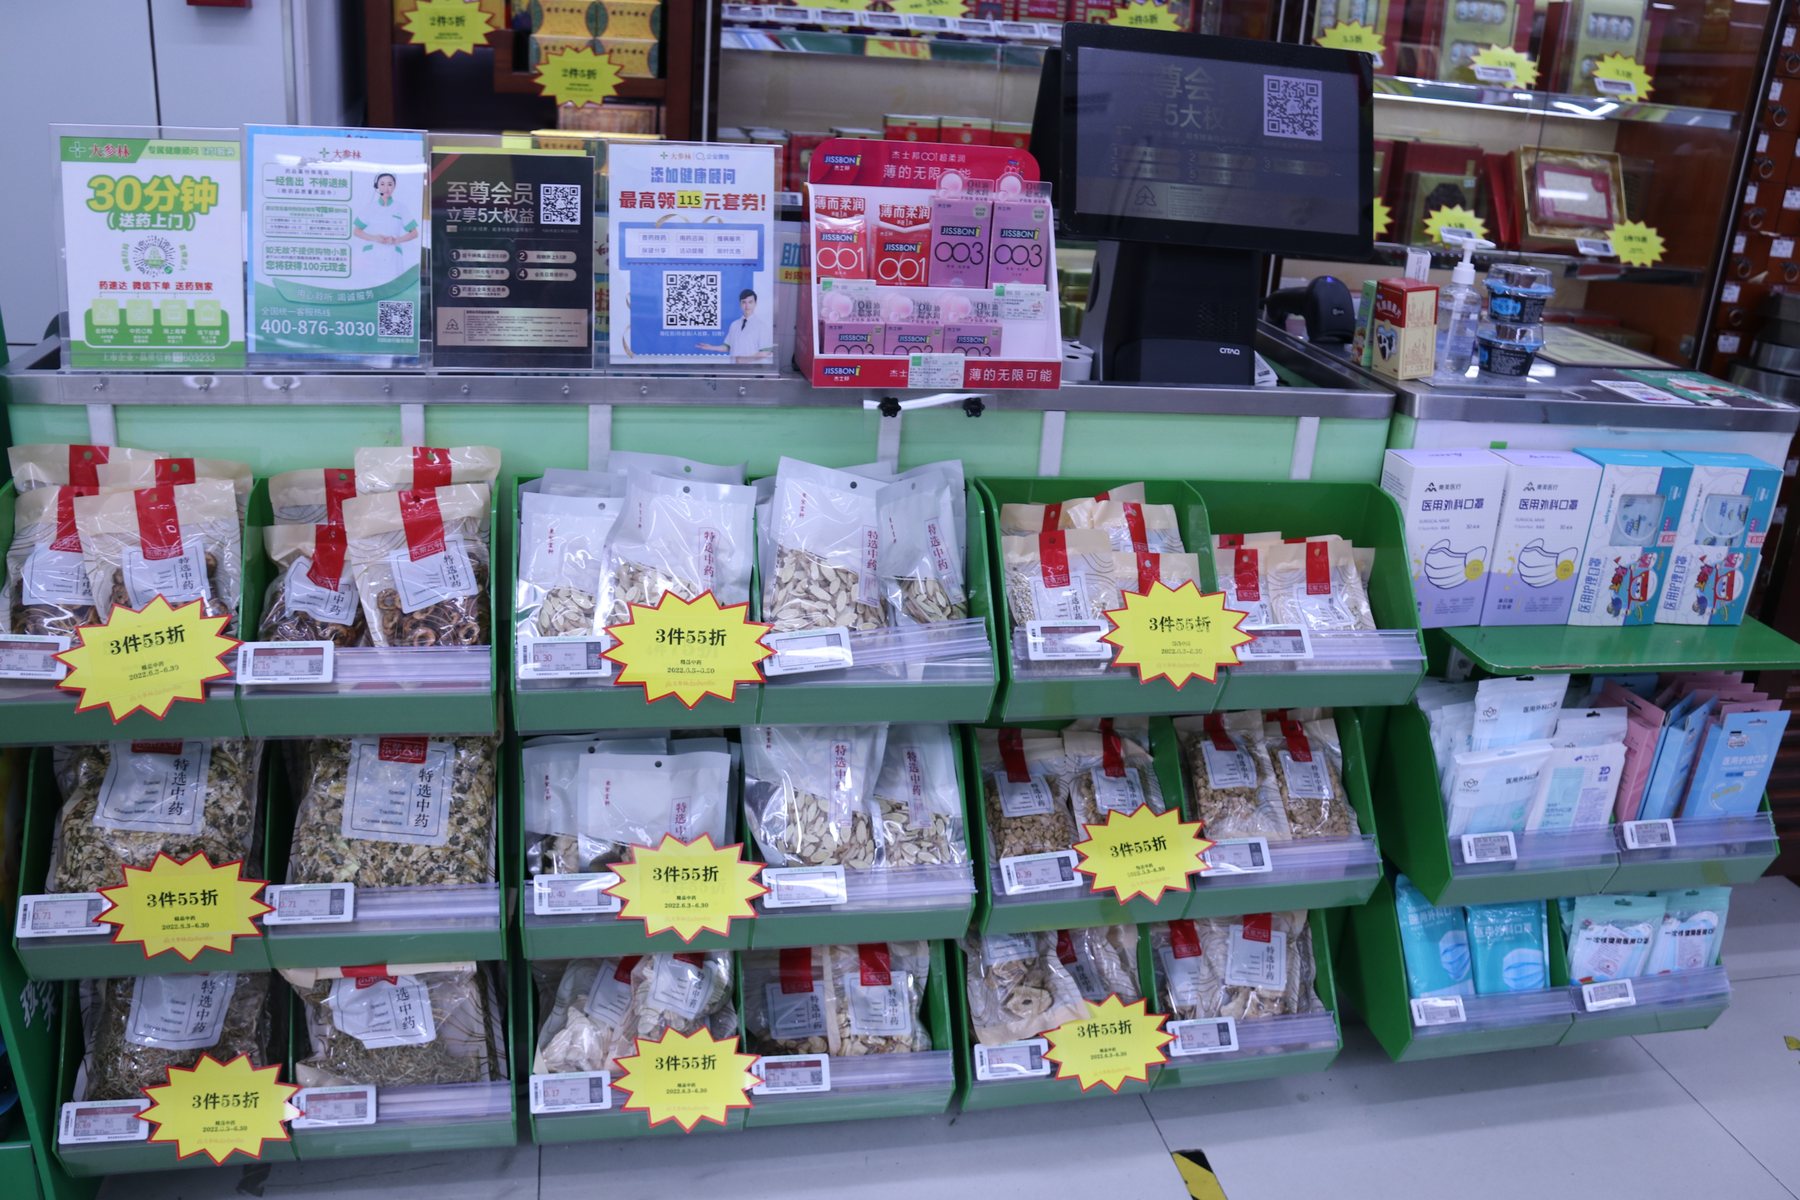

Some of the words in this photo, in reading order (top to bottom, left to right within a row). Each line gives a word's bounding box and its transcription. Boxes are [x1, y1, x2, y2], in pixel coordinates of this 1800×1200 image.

[825, 156, 857, 164] JISSBON
[651, 167, 736, 184] 添加健康顾问
[882, 164, 973, 181] 薄的无限能
[265, 177, 304, 187] 一经售出
[309, 178, 348, 188] 不得退换
[88, 175, 218, 214] 30分钟
[446, 181, 535, 205] 至尊会员
[816, 196, 864, 211] 薄而柔润
[880, 204, 931, 219] 薄而柔润
[446, 207, 535, 224] 立享5大权益
[942, 226, 975, 235] JISSBON
[1002, 230, 1034, 239] JISSBON
[265, 246, 347, 256] 如无故不提供购物小票
[885, 244, 916, 252] JISSBON
[935, 242, 984, 265] 003
[994, 244, 1043, 267] 003
[265, 261, 347, 273] 您将获得100元现金
[817, 247, 864, 272] 001
[879, 257, 926, 282] 001
[99, 281, 128, 291] 药速达
[133, 281, 171, 291] 微信下单
[175, 281, 213, 291] 送药到家
[261, 319, 376, 336] 400-876-3030
[824, 367, 856, 375] JISSBON
[889, 369, 908, 378] 杰士
[968, 367, 1053, 382] 薄的无限可能
[1422, 498, 1484, 511] 医用外科口罩
[1519, 499, 1579, 510] 医用外科口罩
[703, 531, 715, 577] 特选中药
[867, 530, 878, 571] 特选中药
[927, 523, 949, 570] 特选中药
[178, 556, 194, 590] 特选中药
[1578, 557, 1602, 613] 医用护理口罩
[1664, 556, 1688, 611] 医用护理口罩
[329, 592, 344, 616] 中药
[1149, 616, 1211, 633] 3件55折
[110, 624, 186, 655] 3件55折
[655, 628, 727, 647] 3件55折
[907, 751, 922, 796] 特选中药
[168, 758, 190, 816] 特选中药
[415, 768, 434, 828] 特选中药
[1110, 836, 1168, 858] 3件55折
[653, 866, 719, 883] 3件55折
[146, 889, 219, 909] 3件55折
[1409, 910, 1453, 925] 医用外科口
[1474, 923, 1533, 938] 医用外科口罩
[1665, 928, 1714, 936] 一次性使用医用口
[192, 980, 216, 1033] 特选中药
[395, 988, 415, 1030] 选中药
[1077, 1020, 1133, 1037] 3件55折
[655, 1054, 717, 1072] 3件55折
[192, 1092, 260, 1110] 3件55折
